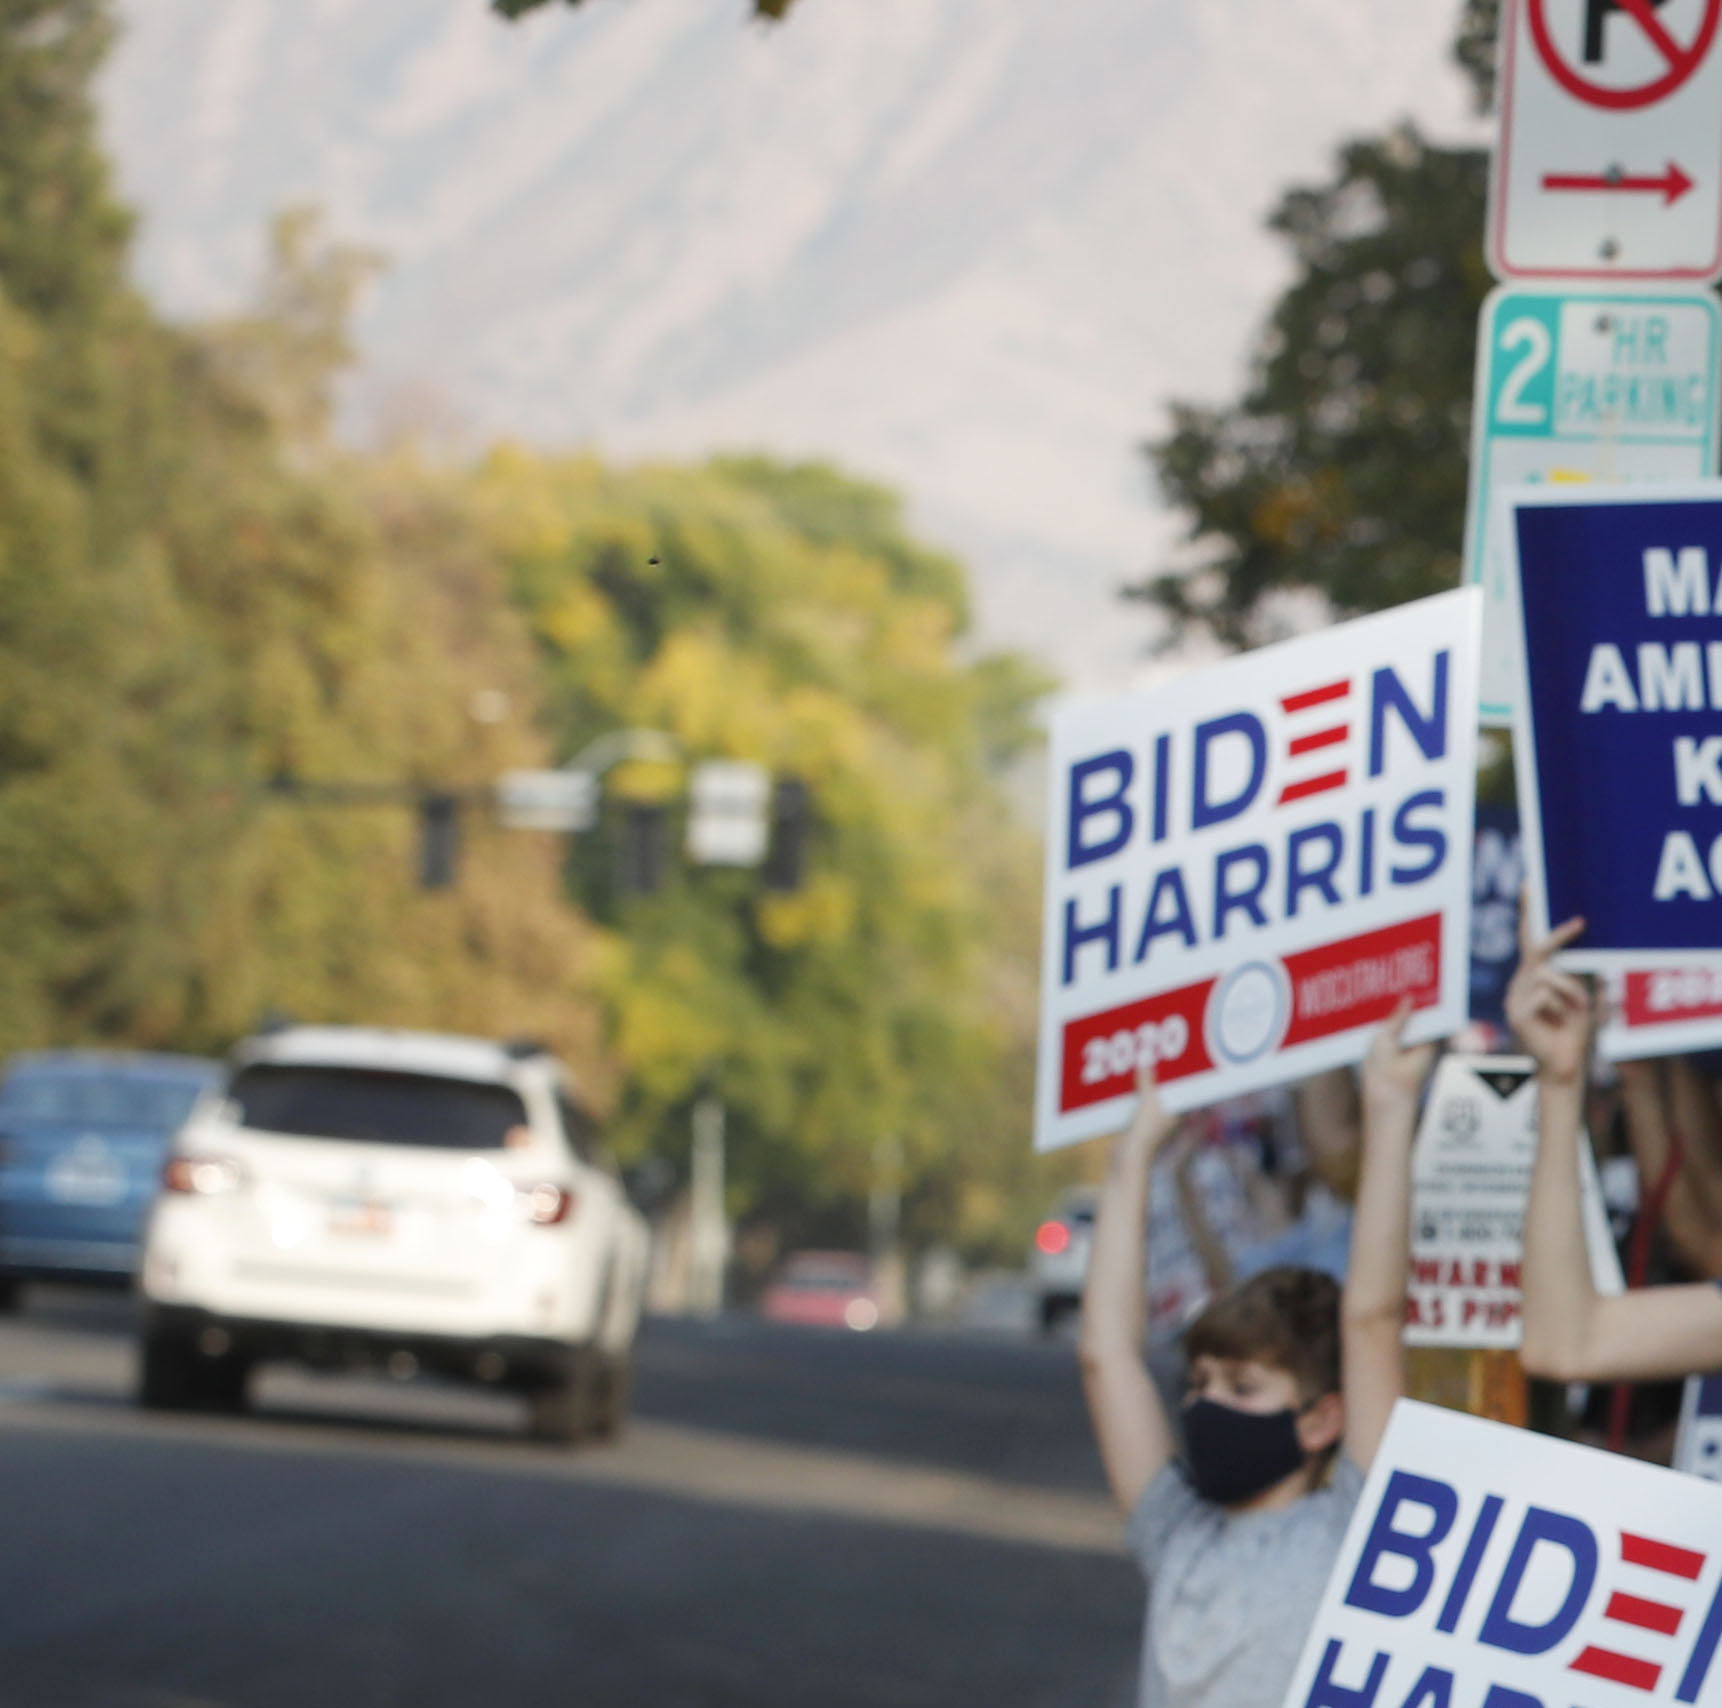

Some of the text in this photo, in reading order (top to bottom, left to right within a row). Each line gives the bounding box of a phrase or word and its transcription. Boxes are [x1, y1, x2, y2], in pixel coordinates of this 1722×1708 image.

[1494, 314, 1668, 426] 2 HR
[1560, 372, 1702, 427] PARKING
[1066, 647, 1451, 872] BIDEN
[1061, 789, 1448, 988] HARRIS
[1079, 1010, 1190, 1087] 2020
